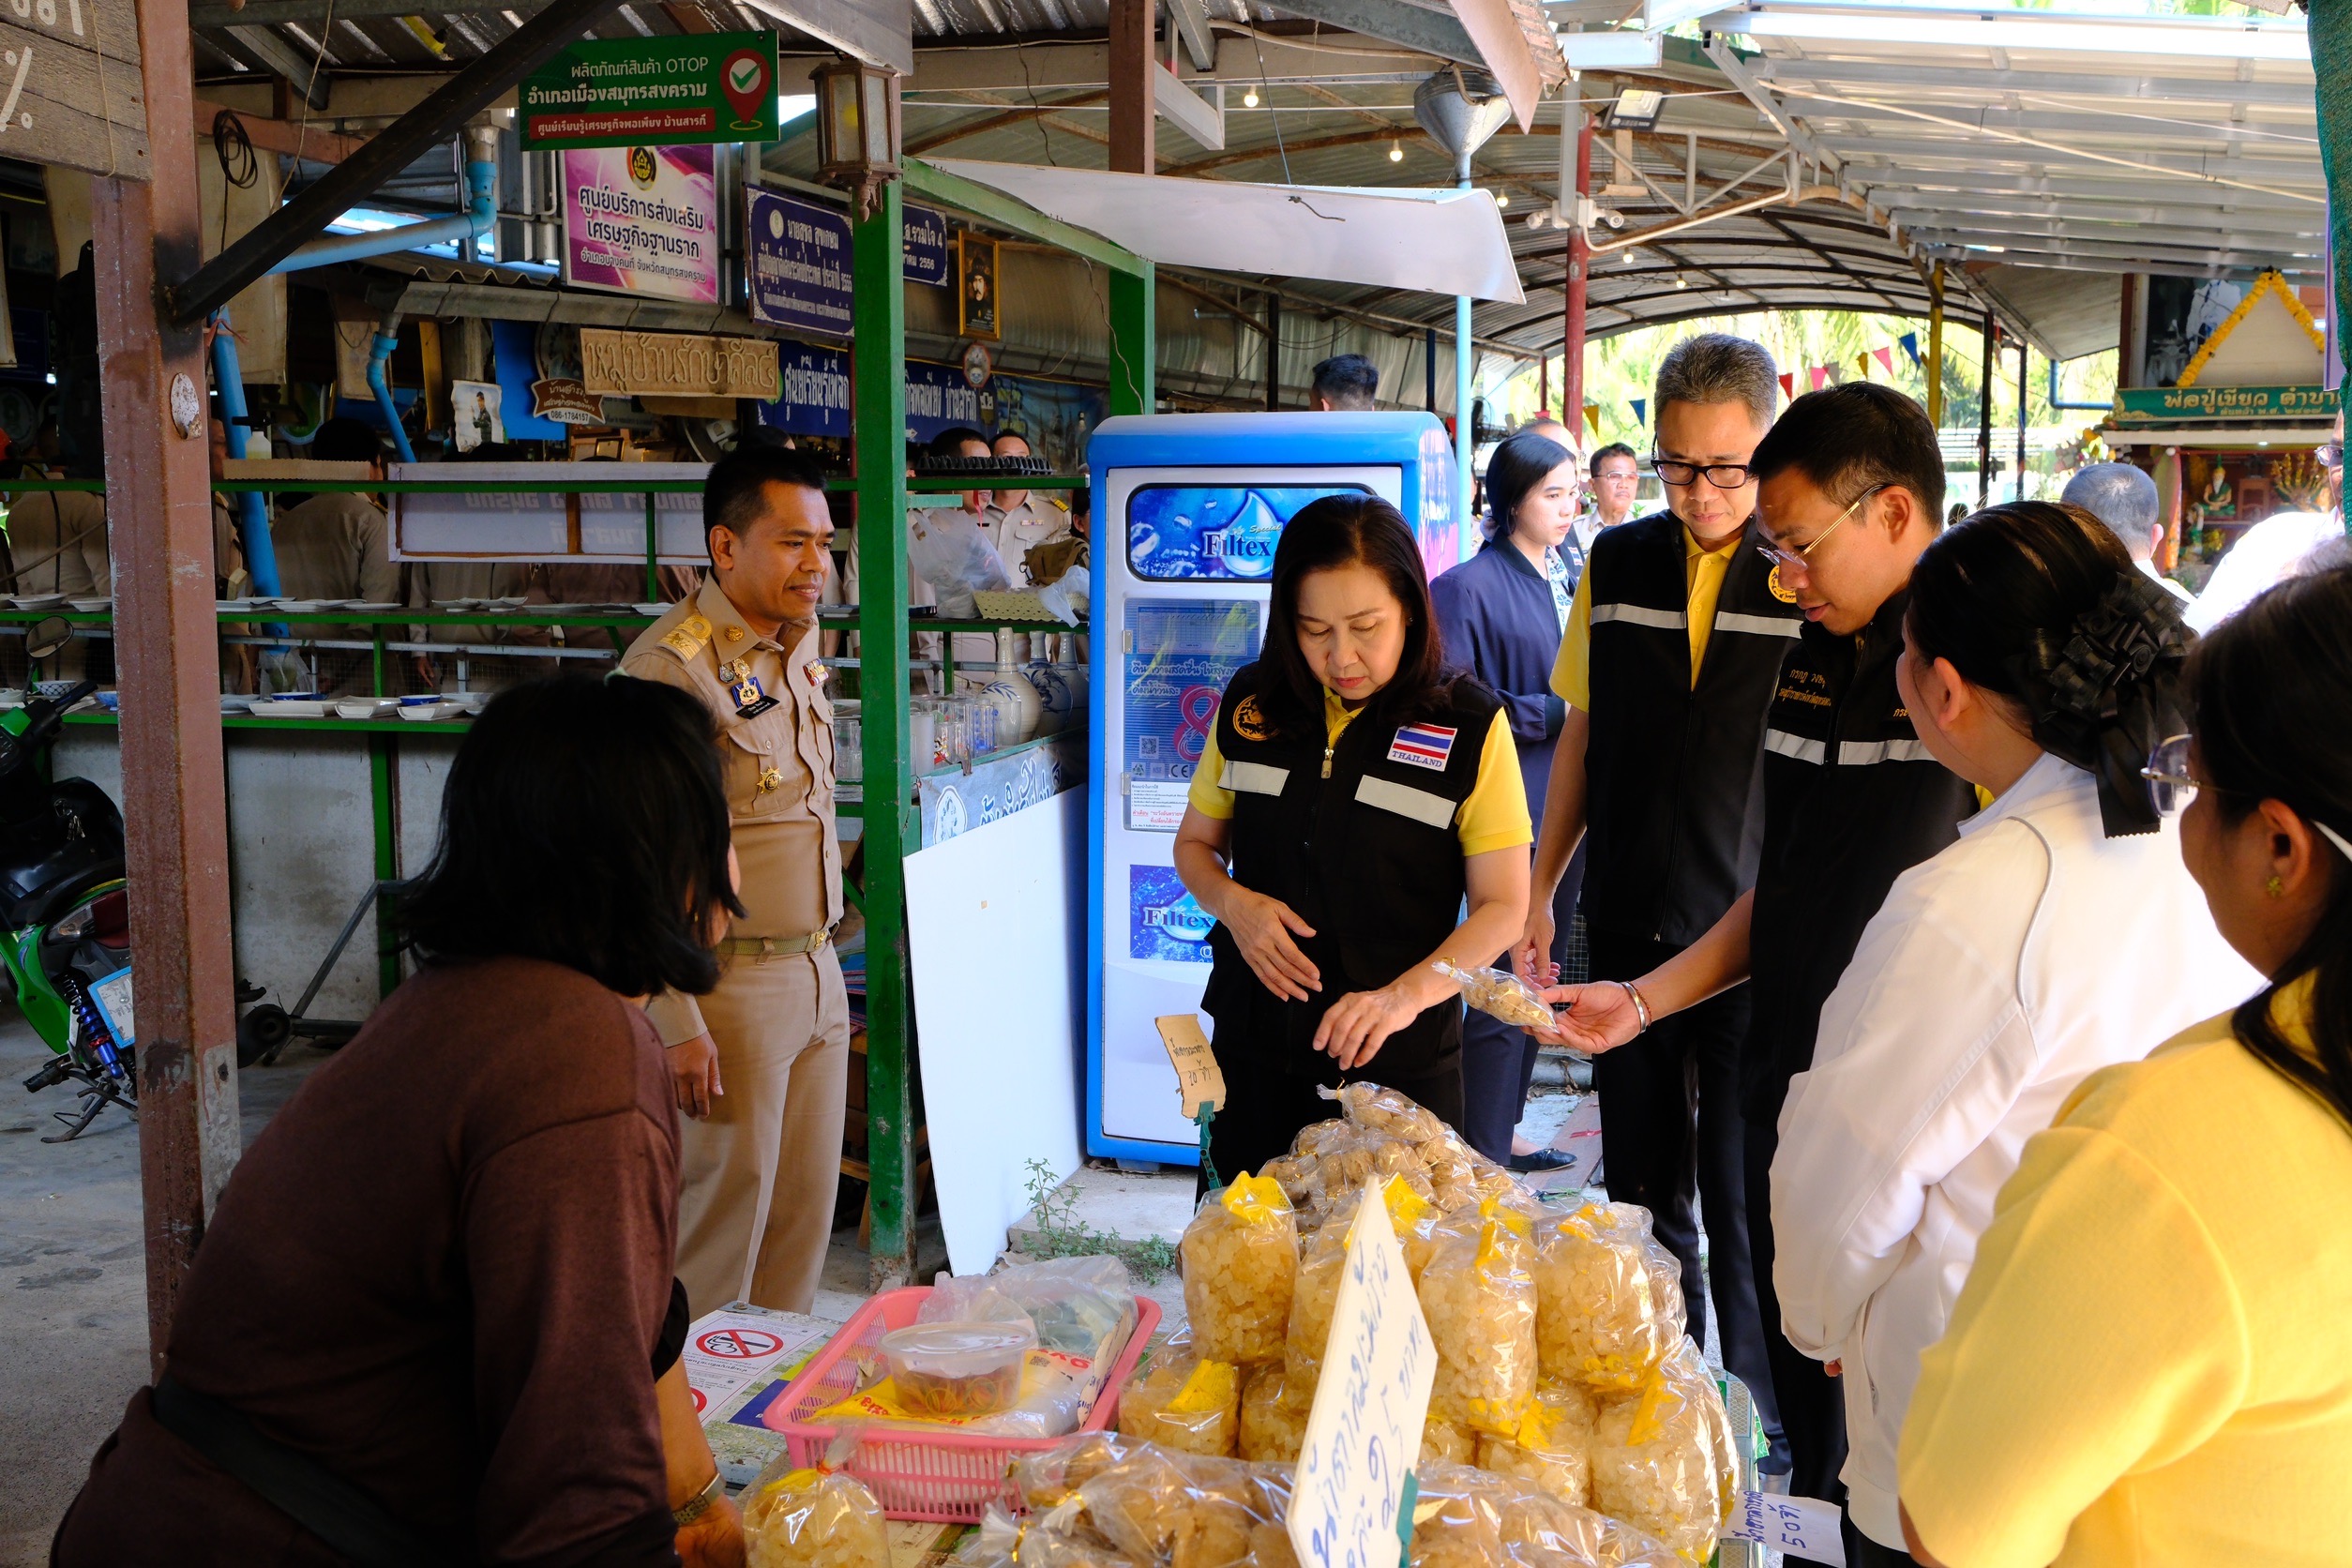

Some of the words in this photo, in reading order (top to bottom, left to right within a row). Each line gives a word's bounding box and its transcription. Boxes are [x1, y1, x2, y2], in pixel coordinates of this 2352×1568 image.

[570, 58, 661, 79] ผลิตภัณฑ์สินค้า
[666, 57, 709, 72] OTOP
[527, 83, 708, 106] อำเภอเมืองสมุทรสงคราม
[537, 115, 662, 134] ศูนย์เรียนรู้เศรษฐกิจพอเพียง
[579, 186, 705, 230] ศูนย์บริการส่งเสริม
[586, 220, 701, 258] เศรษฐกิจฐานราก
[637, 261, 706, 281] จังหวัดสมุทรสงคราม
[2164, 387, 2269, 415] พ่อปู่เขียว
[1206, 533, 1271, 557] Filtex
[1392, 750, 1442, 767] THAILAND
[1147, 909, 1213, 927] Filtex
